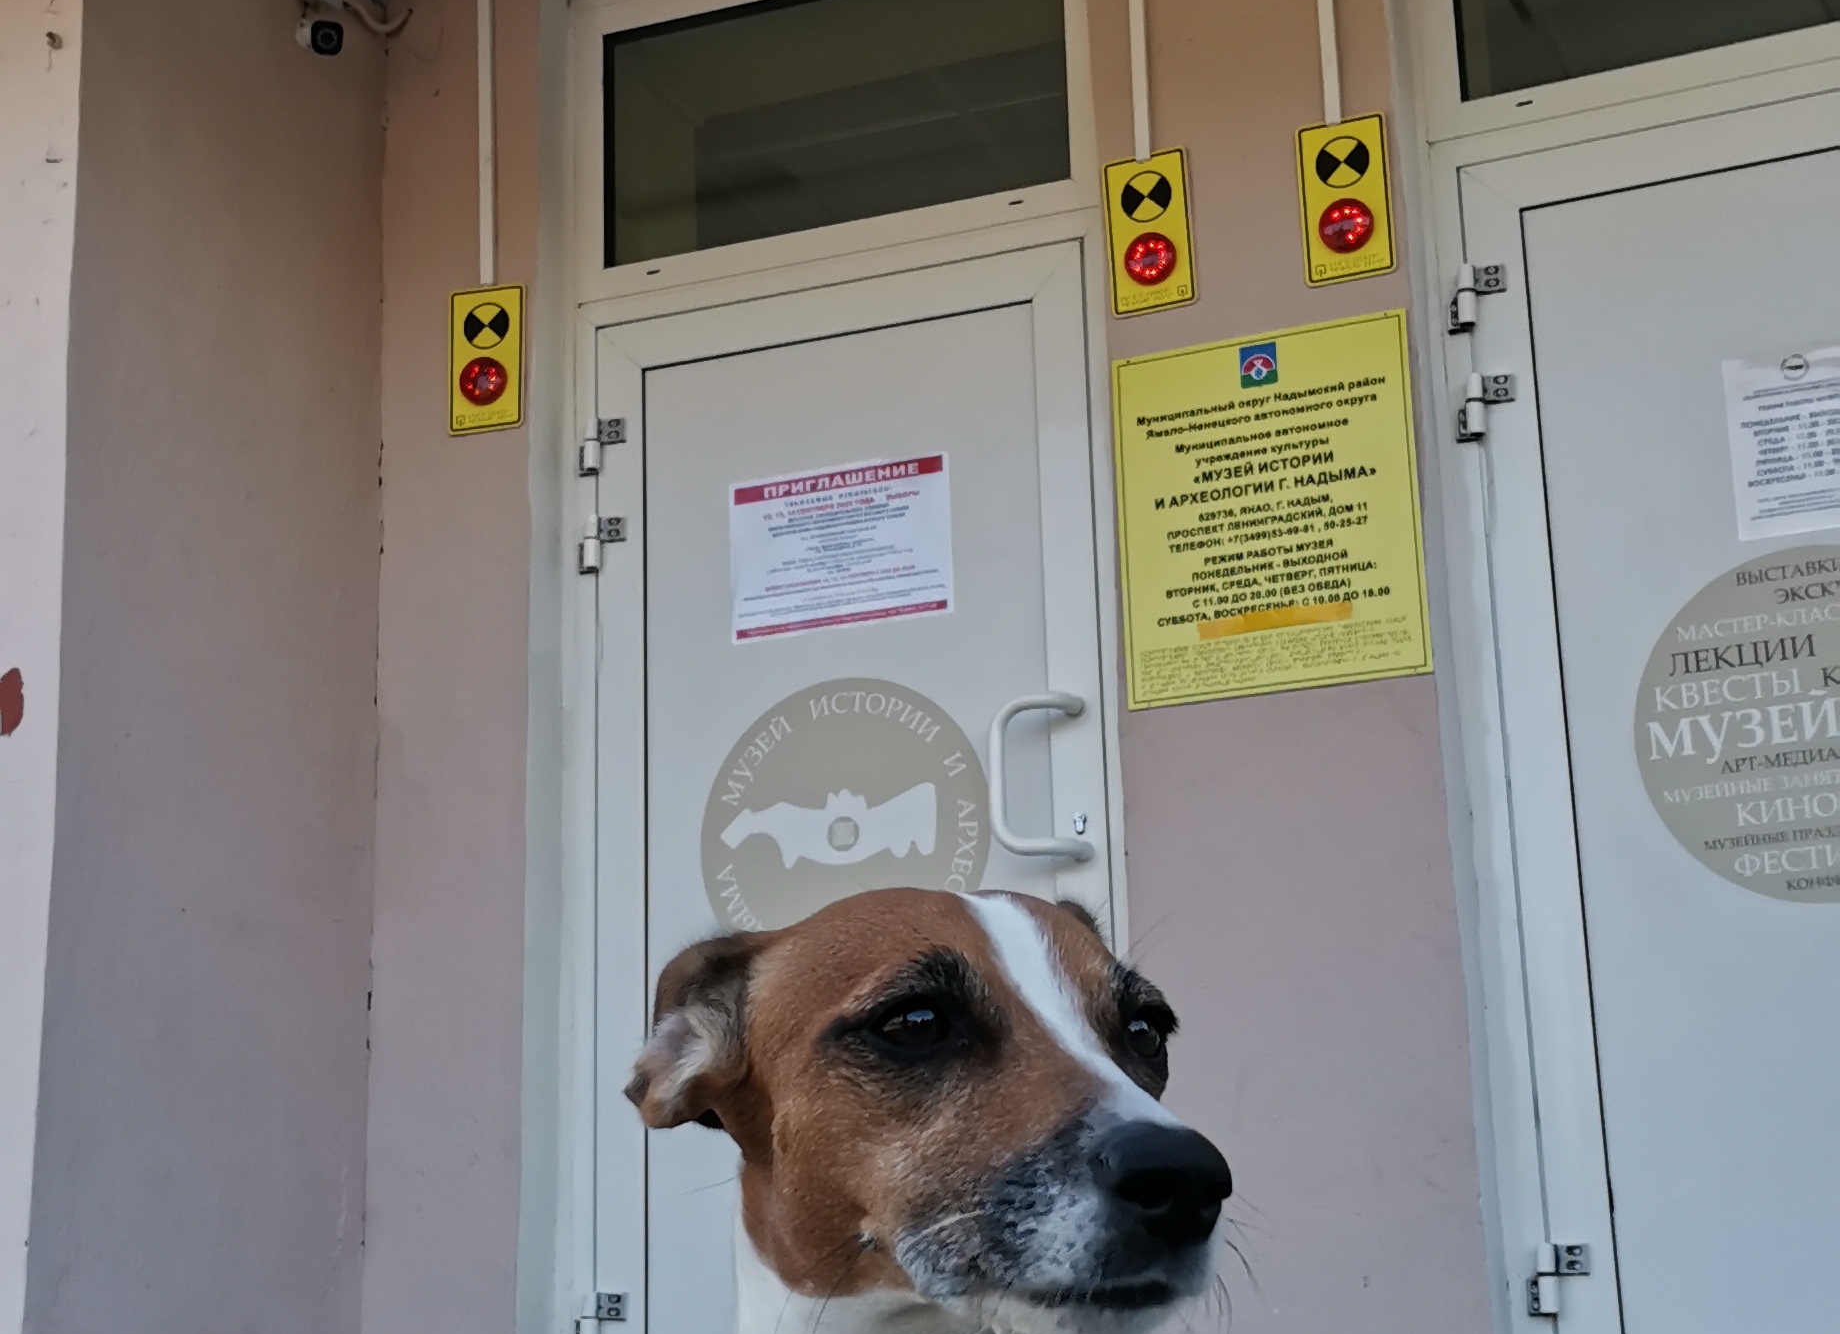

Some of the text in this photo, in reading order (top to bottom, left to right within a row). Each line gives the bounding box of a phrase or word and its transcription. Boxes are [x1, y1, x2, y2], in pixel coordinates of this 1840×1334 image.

[1137, 375, 1386, 426] Муниципальный округ Надымский район
[1146, 393, 1377, 440] Ямало-Ненецкого автономного округа
[1175, 418, 1349, 454] Муниципальное автономное
[1195, 437, 1329, 467] учреждение культуры
[763, 462, 920, 500] ПРИГЛАШЕНИЕ
[1193, 450, 1334, 484] «МУЗЕЙ ИСТОРИИ
[1155, 498, 1165, 510] И
[1168, 479, 1275, 509] АРХЕОЛОГИИ
[1294, 465, 1377, 488] НАДЫМА»
[1167, 523, 1224, 541] ПРОСПЕКТ
[1328, 504, 1354, 518] ДОМ
[1356, 501, 1368, 512] 11
[1192, 562, 1273, 582] ПОНЕДЕЛЬНИК
[1283, 550, 1348, 568] ВЫХОДНОЙ
[1204, 538, 1333, 565] РЕЖИМ РАБОТЫ МУЗЕЯ
[1264, 569, 1317, 586] ЧЕТВЕРГ,
[1343, 589, 1359, 602] ДО
[1192, 597, 1200, 608] С
[1231, 592, 1248, 605] ДО
[1669, 633, 1817, 677] ЛЕКЦИИ
[1654, 668, 1802, 713] КВЕСТЫ
[808, 690, 942, 745] ИСТОРИИ
[1645, 688, 1840, 765] МУЗЕЙ
[721, 715, 794, 807] МУЗЕЙ
[942, 750, 968, 777] И
[1663, 777, 1773, 803] МУЗЕЙНЫЕ
[1704, 831, 1789, 850] МУЗЕЙНЫЕ
